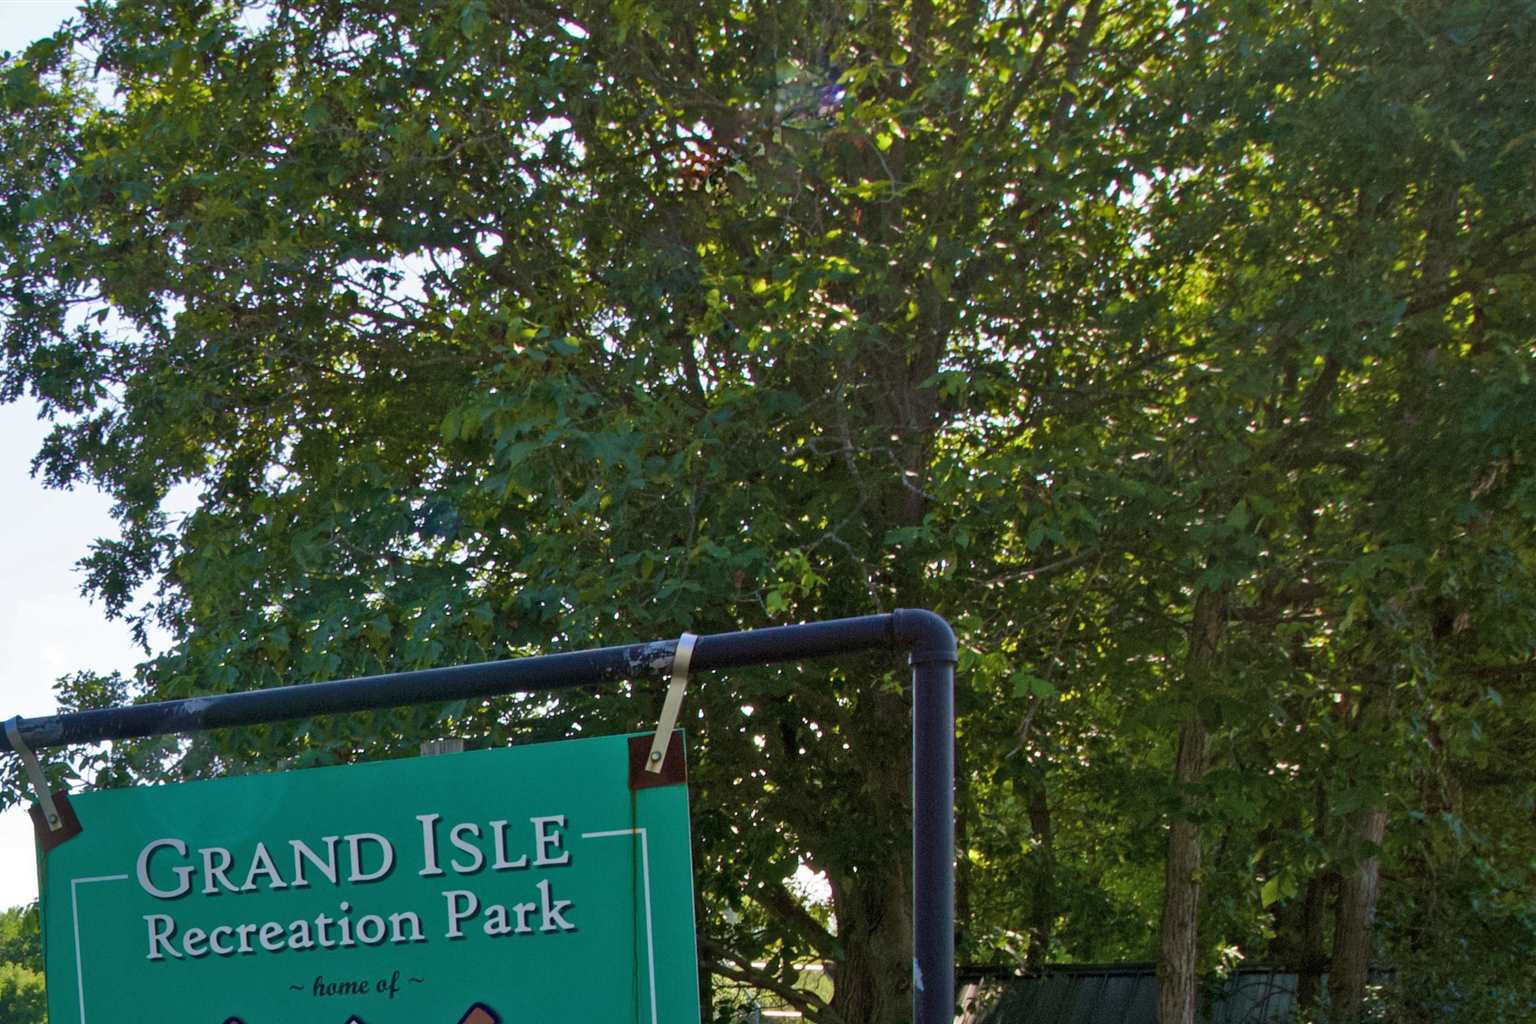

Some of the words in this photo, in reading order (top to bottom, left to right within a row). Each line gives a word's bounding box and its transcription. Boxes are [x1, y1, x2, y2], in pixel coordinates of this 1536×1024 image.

[136, 832, 395, 899] GRAND
[416, 813, 570, 877] ISLE
[143, 901, 425, 960] Recreation
[442, 879, 575, 938] Park
[312, 975, 370, 998] home
[376, 970, 401, 999] of
